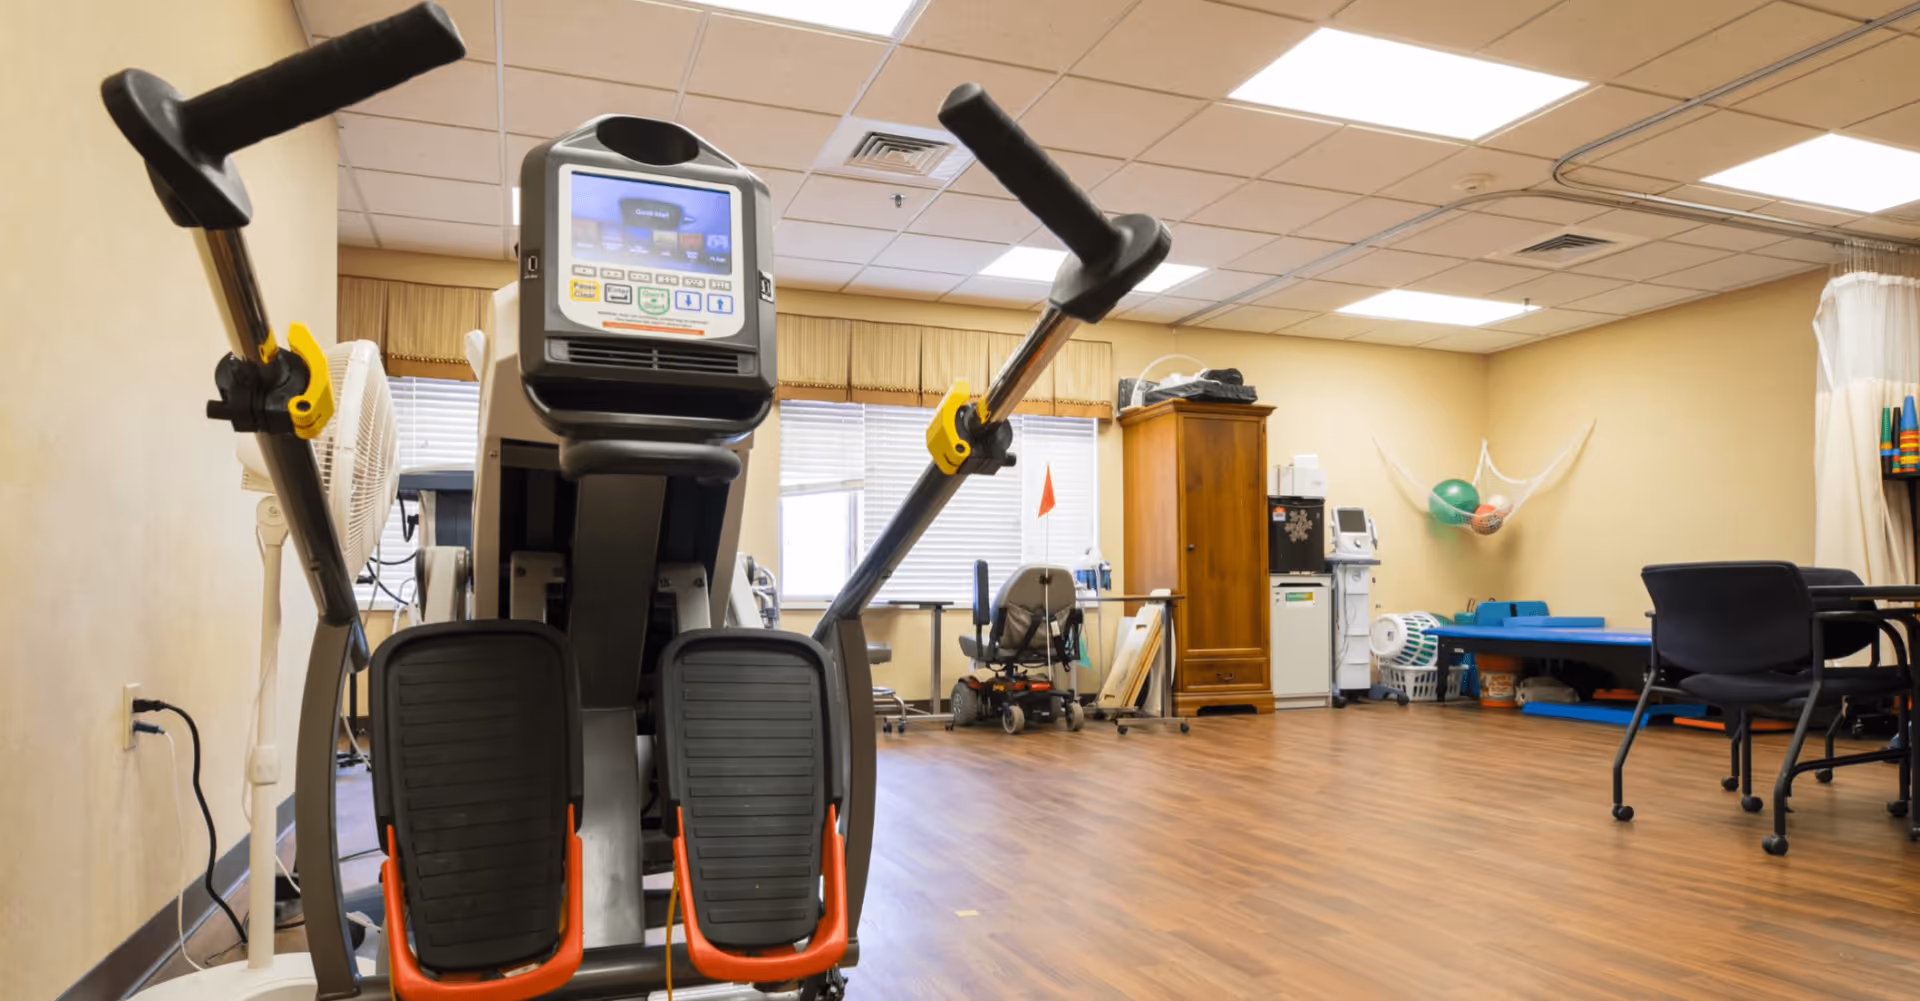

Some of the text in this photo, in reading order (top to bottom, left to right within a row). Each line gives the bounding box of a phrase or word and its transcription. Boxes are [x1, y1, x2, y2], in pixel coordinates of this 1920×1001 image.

[573, 282, 597, 291] Pause
[607, 286, 629, 295] Enter
[574, 290, 596, 299] Clear
